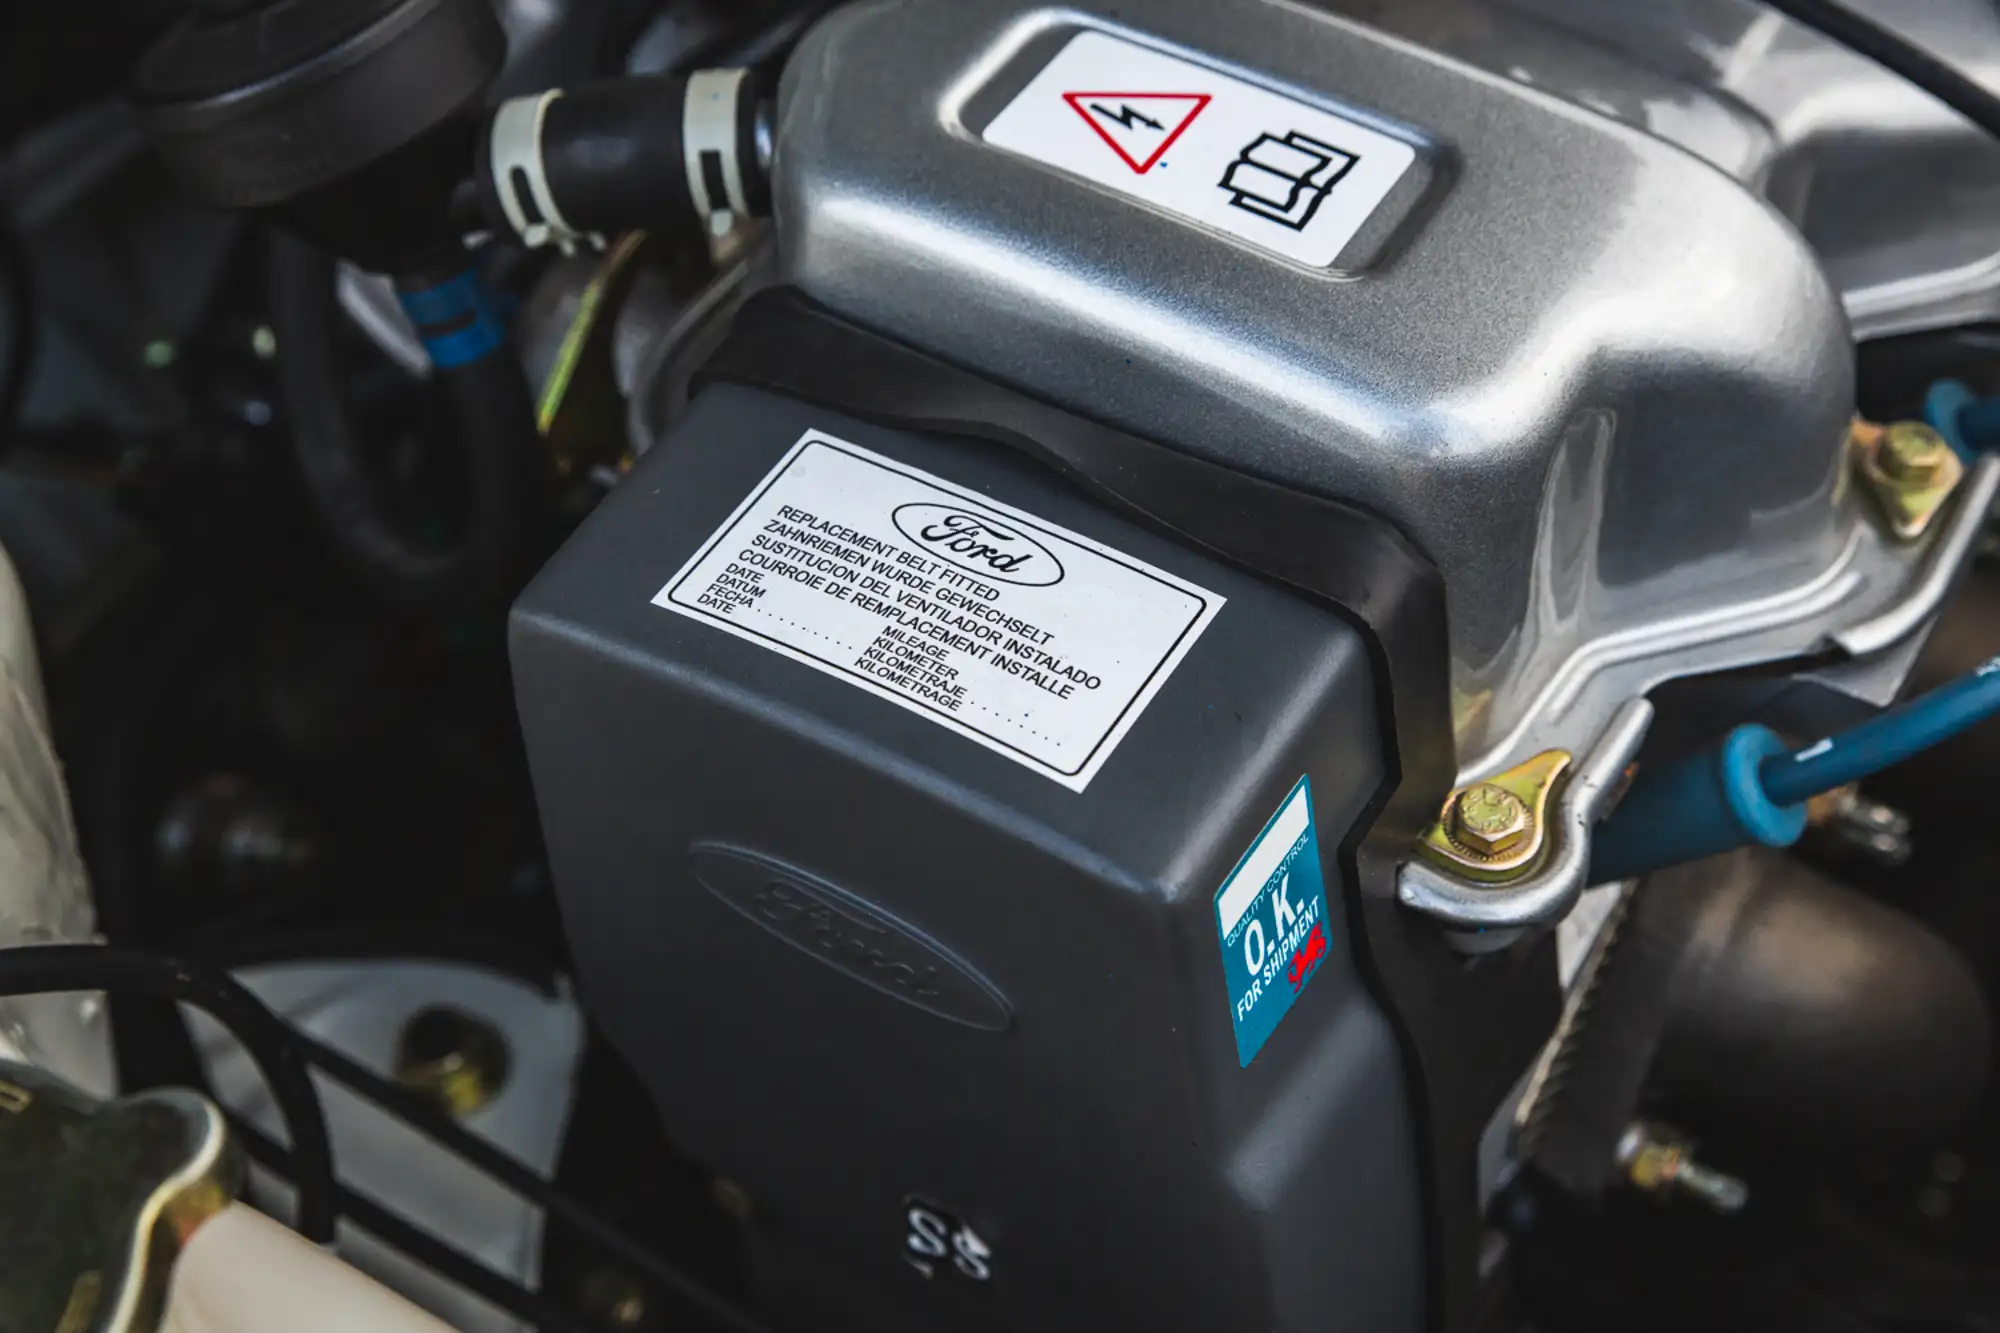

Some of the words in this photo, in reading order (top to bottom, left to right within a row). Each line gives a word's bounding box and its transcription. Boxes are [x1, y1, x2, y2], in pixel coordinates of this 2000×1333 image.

[777, 505, 899, 559] REPLACEMENT
[896, 550, 941, 576] BELT
[938, 567, 1001, 602] FITTED
[920, 514, 1033, 573] Ford
[706, 583, 755, 608] FECHA
[715, 573, 767, 599] DATUM
[724, 562, 765, 584] DATE
[763, 519, 870, 568] ZAHNRIEMEN
[871, 556, 936, 595] WURDE
[935, 586, 1055, 646] GEWECHSELT
[697, 593, 737, 615] DATE
[738, 549, 826, 590] COURROIE
[824, 581, 852, 601] DE
[849, 591, 993, 660] REMPLACEMENT
[990, 652, 1075, 700] INSTALLE
[752, 534, 862, 584] SUSTITUCION
[859, 574, 890, 599] DEL
[896, 590, 1004, 646] VENTILADOR
[1003, 637, 1101, 690] INSTALADO
[872, 636, 960, 681] KILOMETER
[881, 625, 950, 662] MILEAGE
[854, 656, 963, 712] KILOMETRAGE
[863, 646, 967, 699] KILOMETRAJE
[1227, 890, 1266, 948] QUALITY
[1266, 834, 1310, 894] CONTROL
[1244, 872, 1305, 977] O.K.
[1236, 978, 1263, 1023] FOR
[1264, 895, 1320, 986] SHIPMENT
